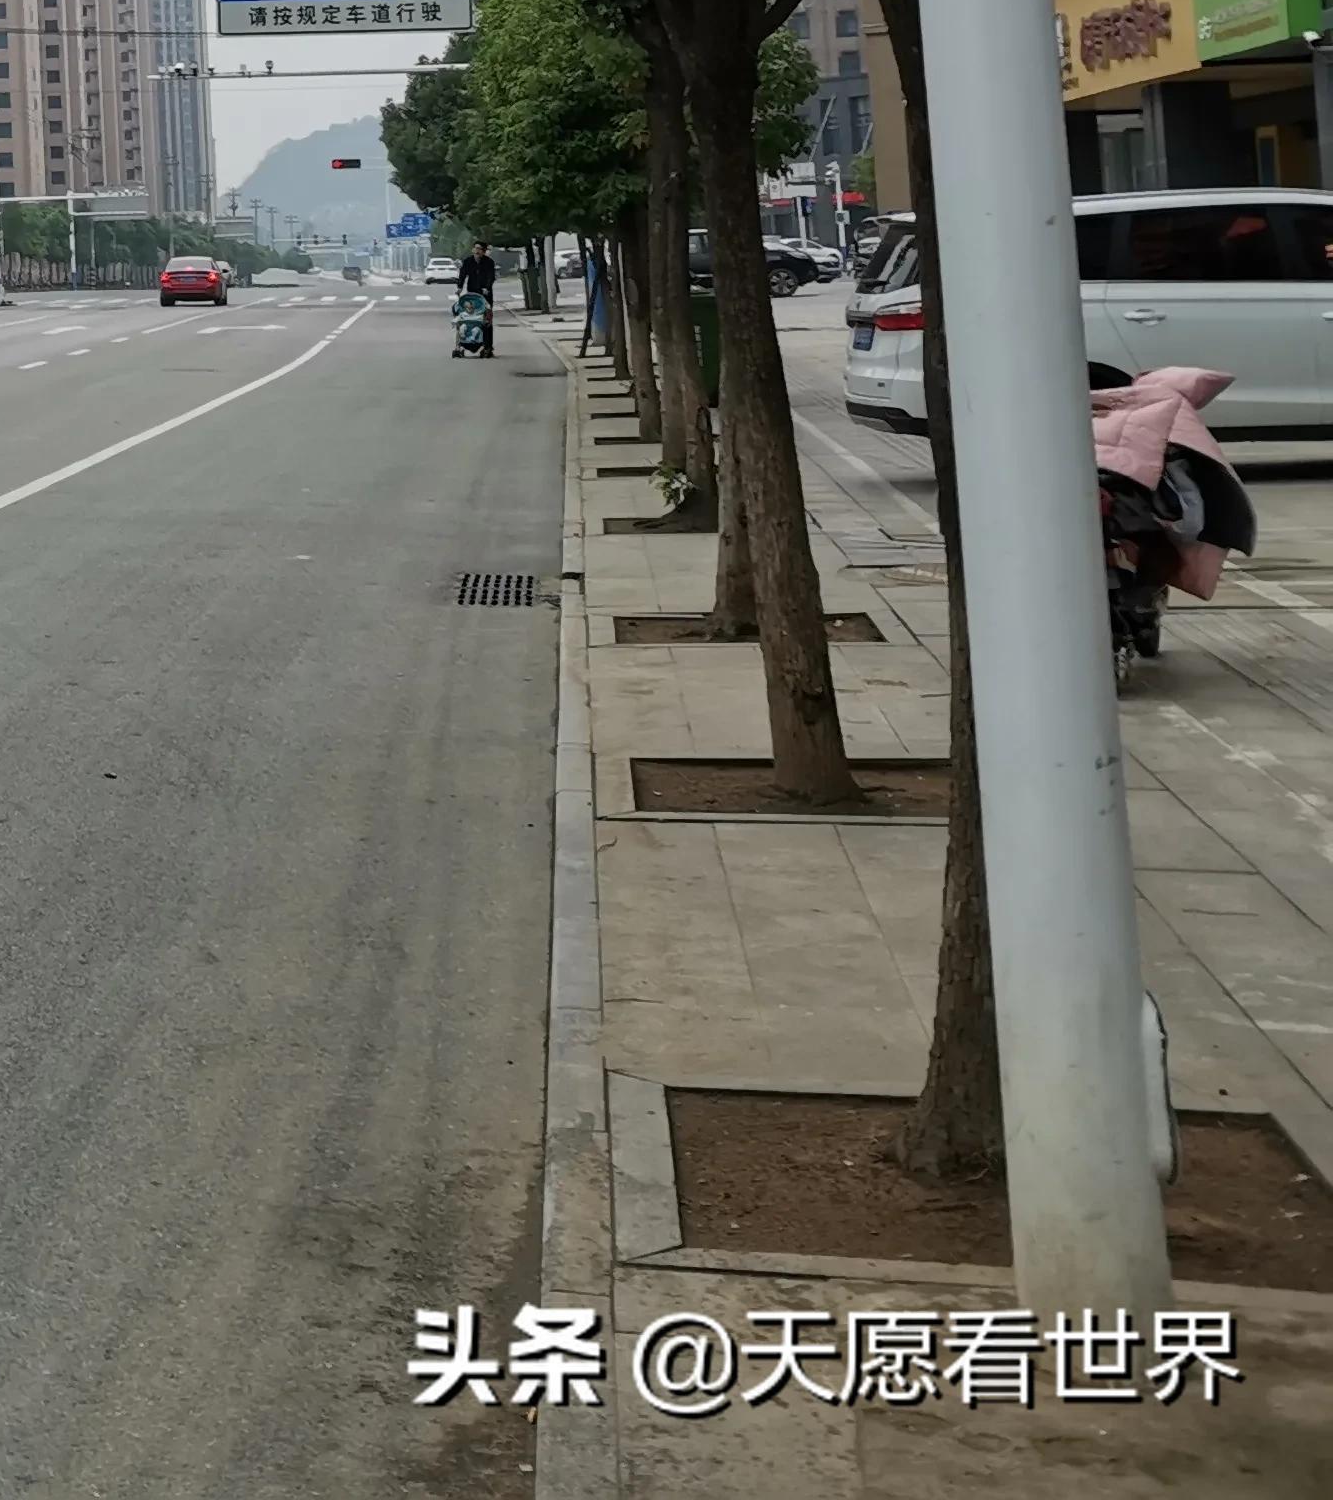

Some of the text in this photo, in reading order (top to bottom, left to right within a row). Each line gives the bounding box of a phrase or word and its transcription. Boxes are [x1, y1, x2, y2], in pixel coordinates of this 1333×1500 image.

[248, 1, 444, 27] 请按规定车道行驶
